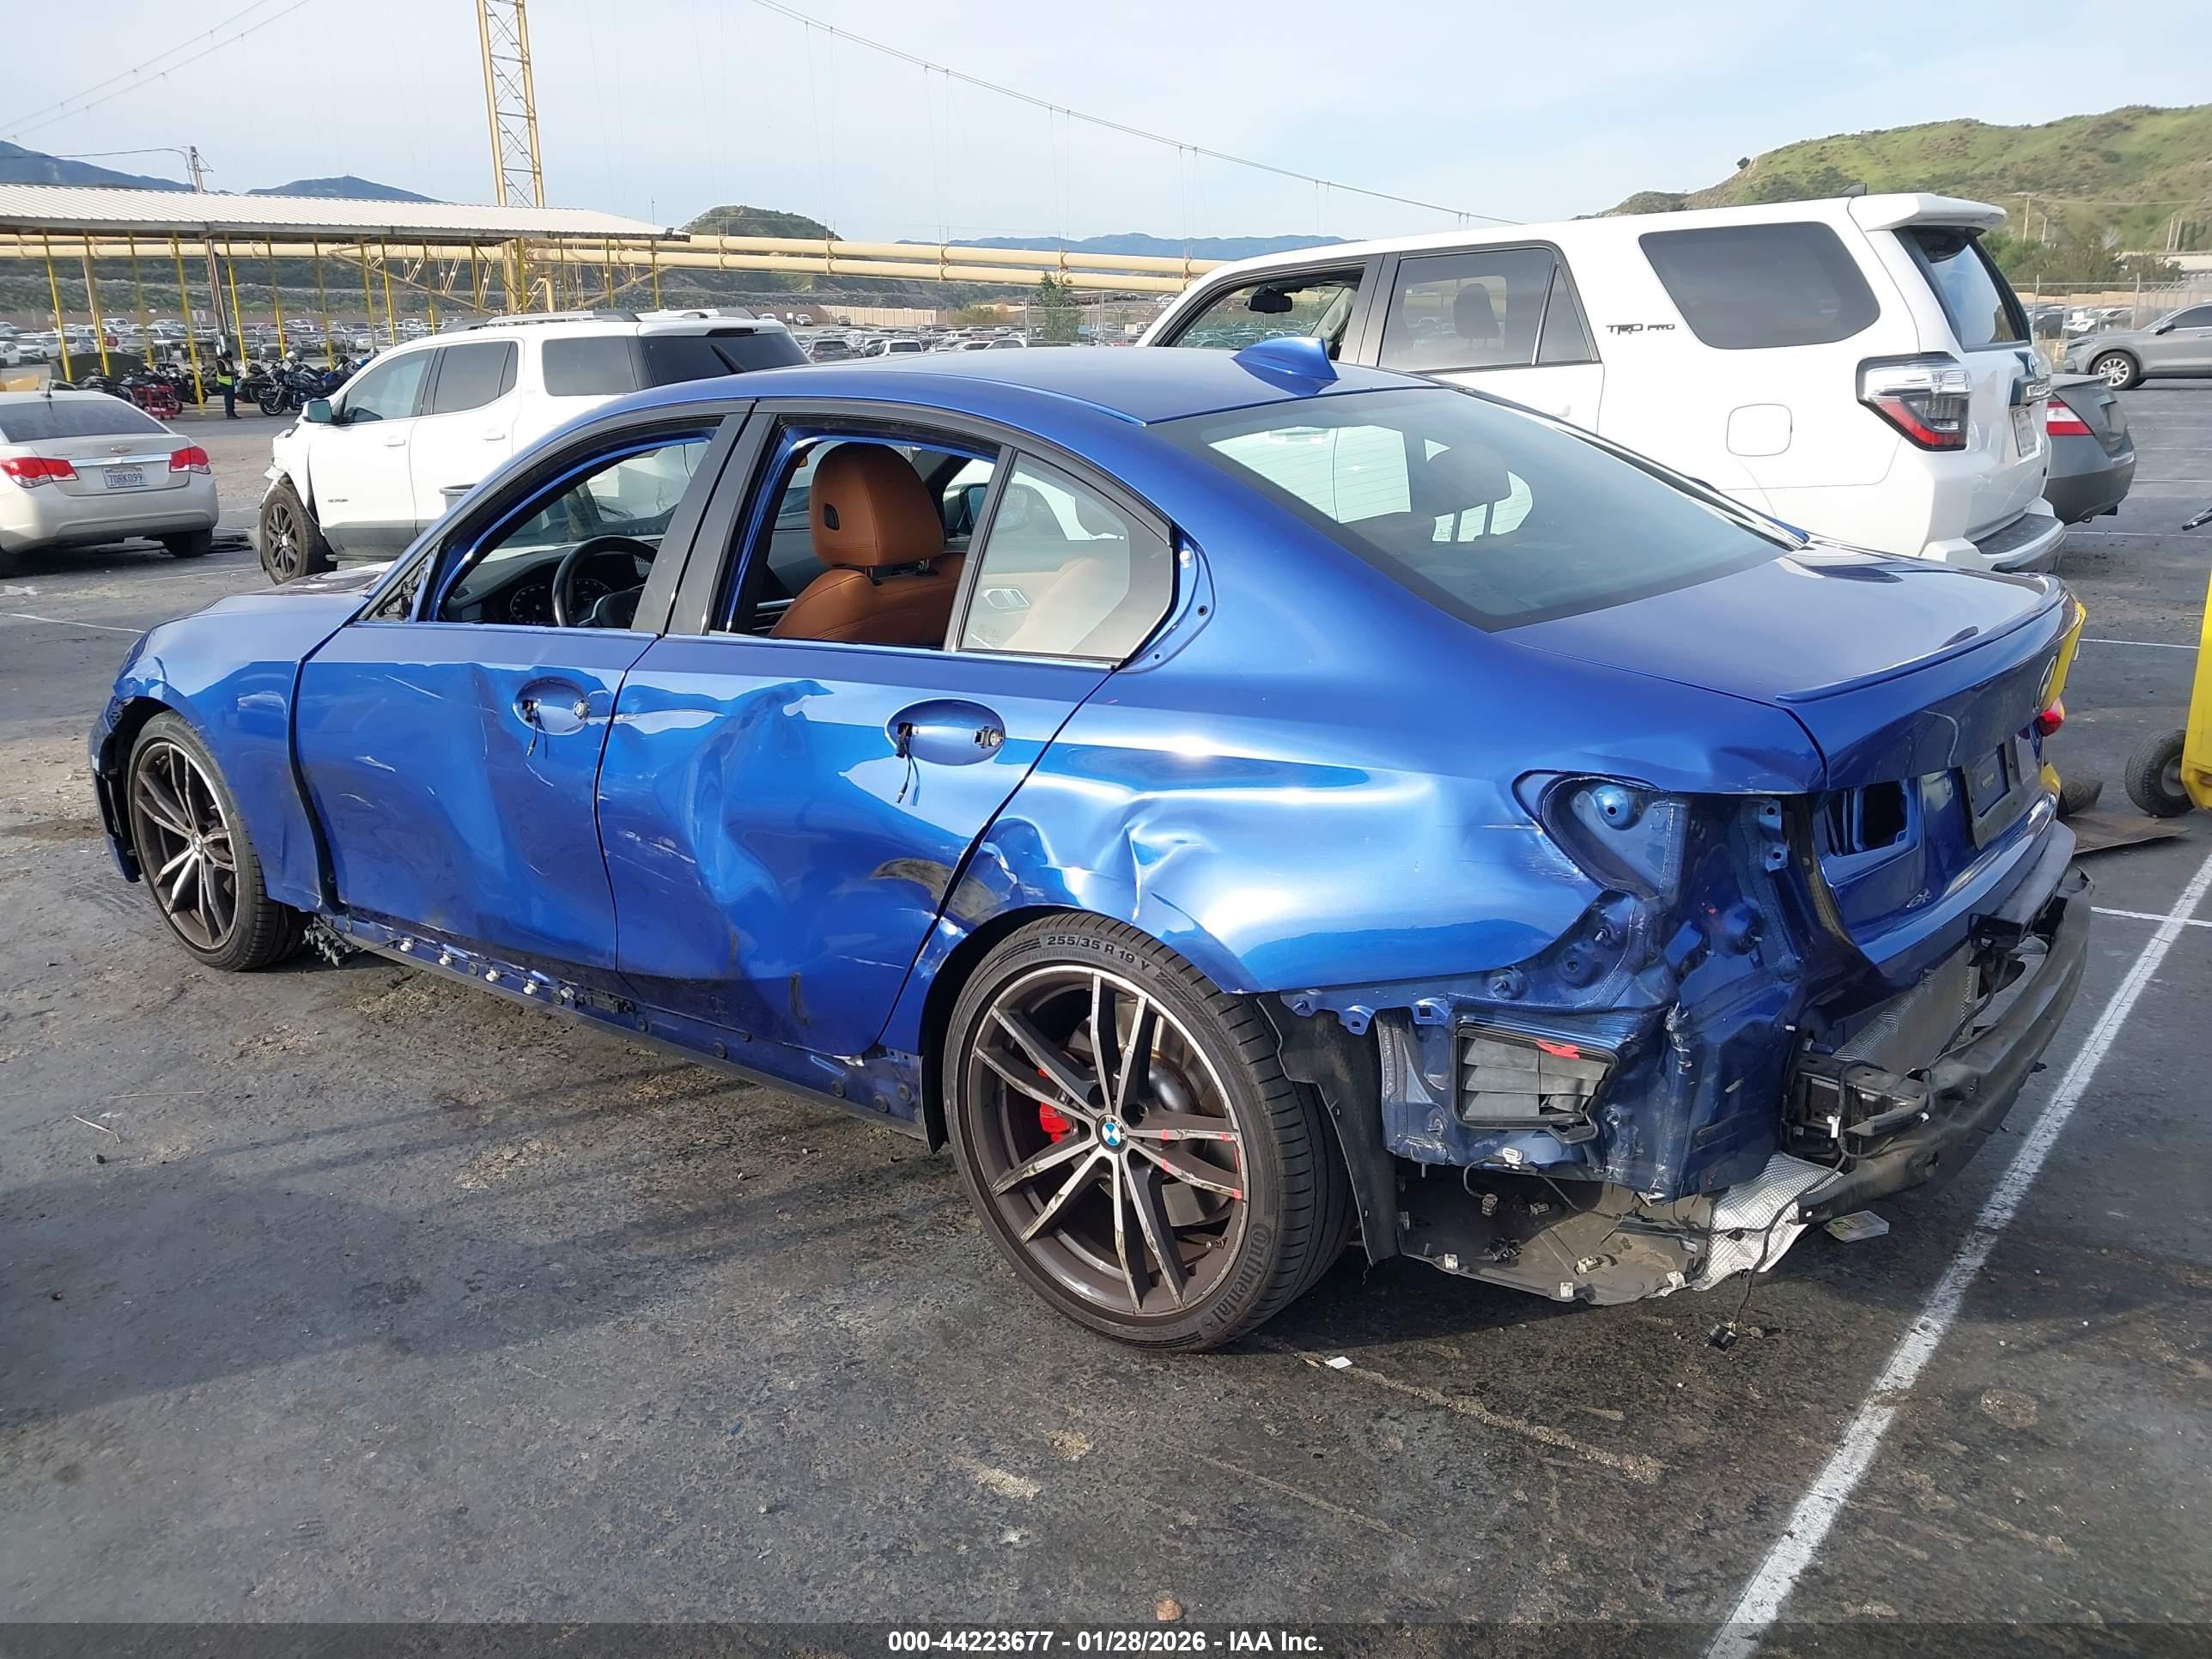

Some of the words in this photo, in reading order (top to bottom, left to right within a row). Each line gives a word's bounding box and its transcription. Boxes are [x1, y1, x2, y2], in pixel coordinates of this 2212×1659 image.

[1606, 323, 1644, 335] TRD
[1047, 935, 1102, 951] 255/35
[1103, 944, 1115, 956] R
[1118, 950, 1136, 964] 19
[1211, 1222, 1273, 1324] Continental
